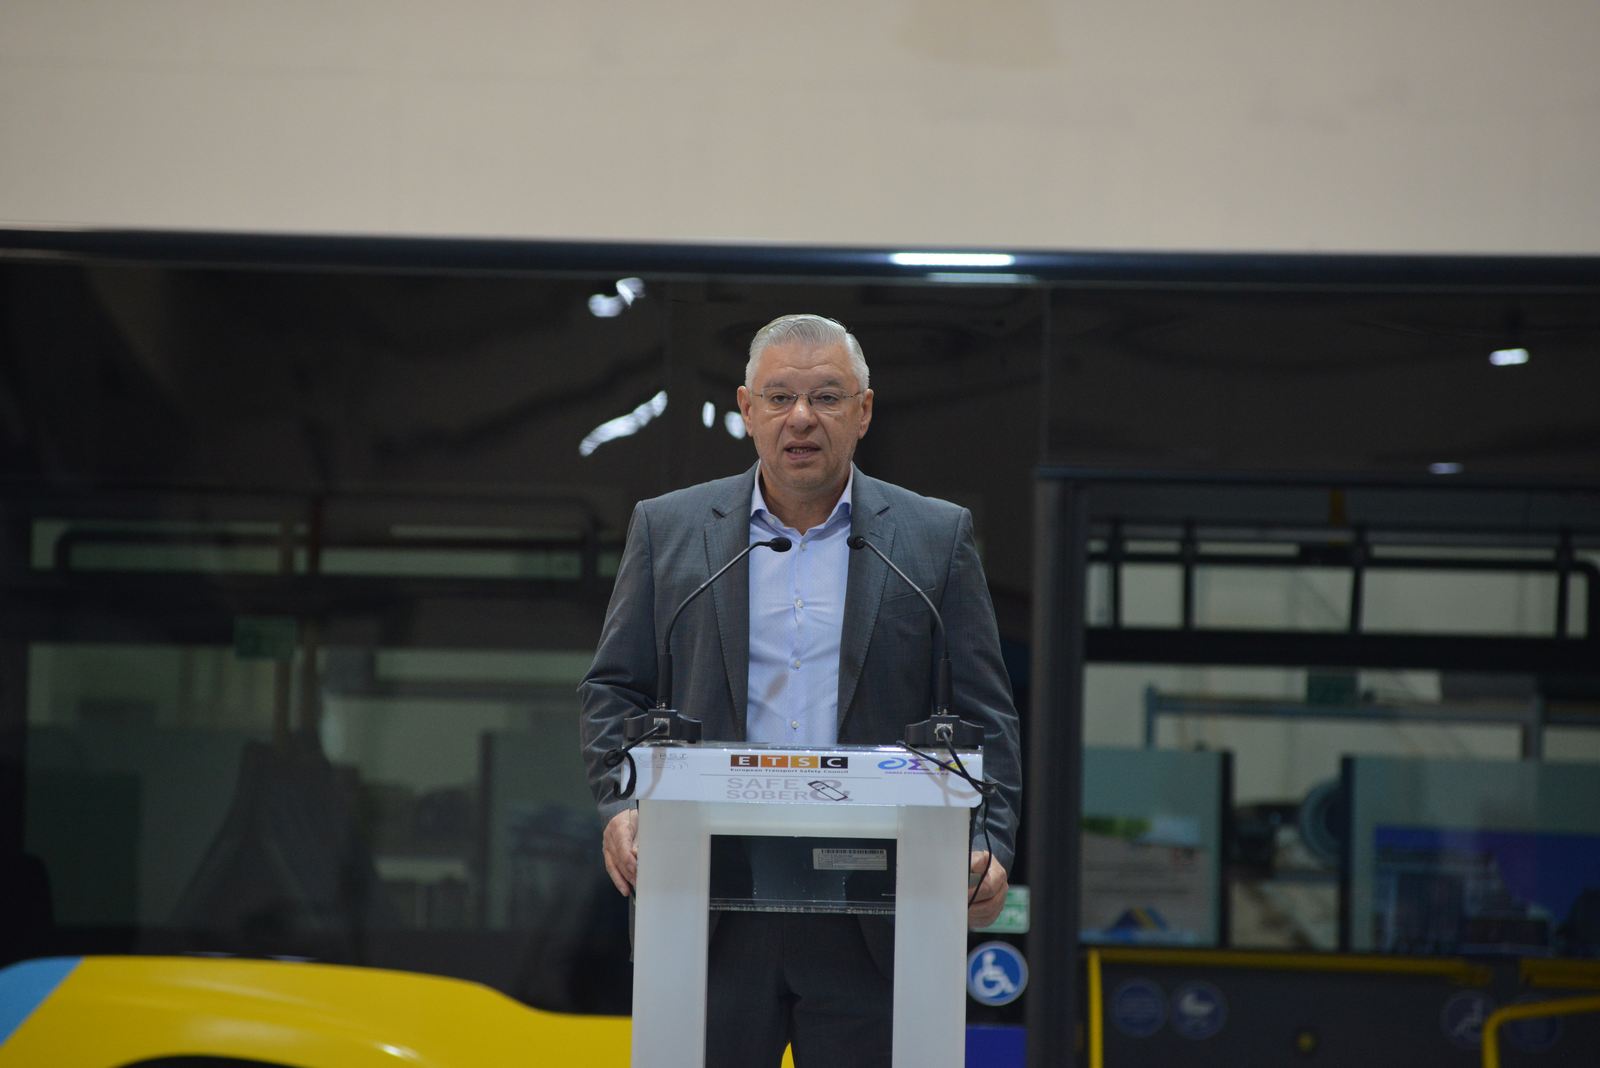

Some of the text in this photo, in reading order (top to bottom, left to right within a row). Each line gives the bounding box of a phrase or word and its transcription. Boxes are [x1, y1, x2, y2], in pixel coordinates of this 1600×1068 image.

[736, 755, 845, 768] ETSC
[727, 777, 801, 790] SAFE
[726, 790, 808, 801] SOBER
